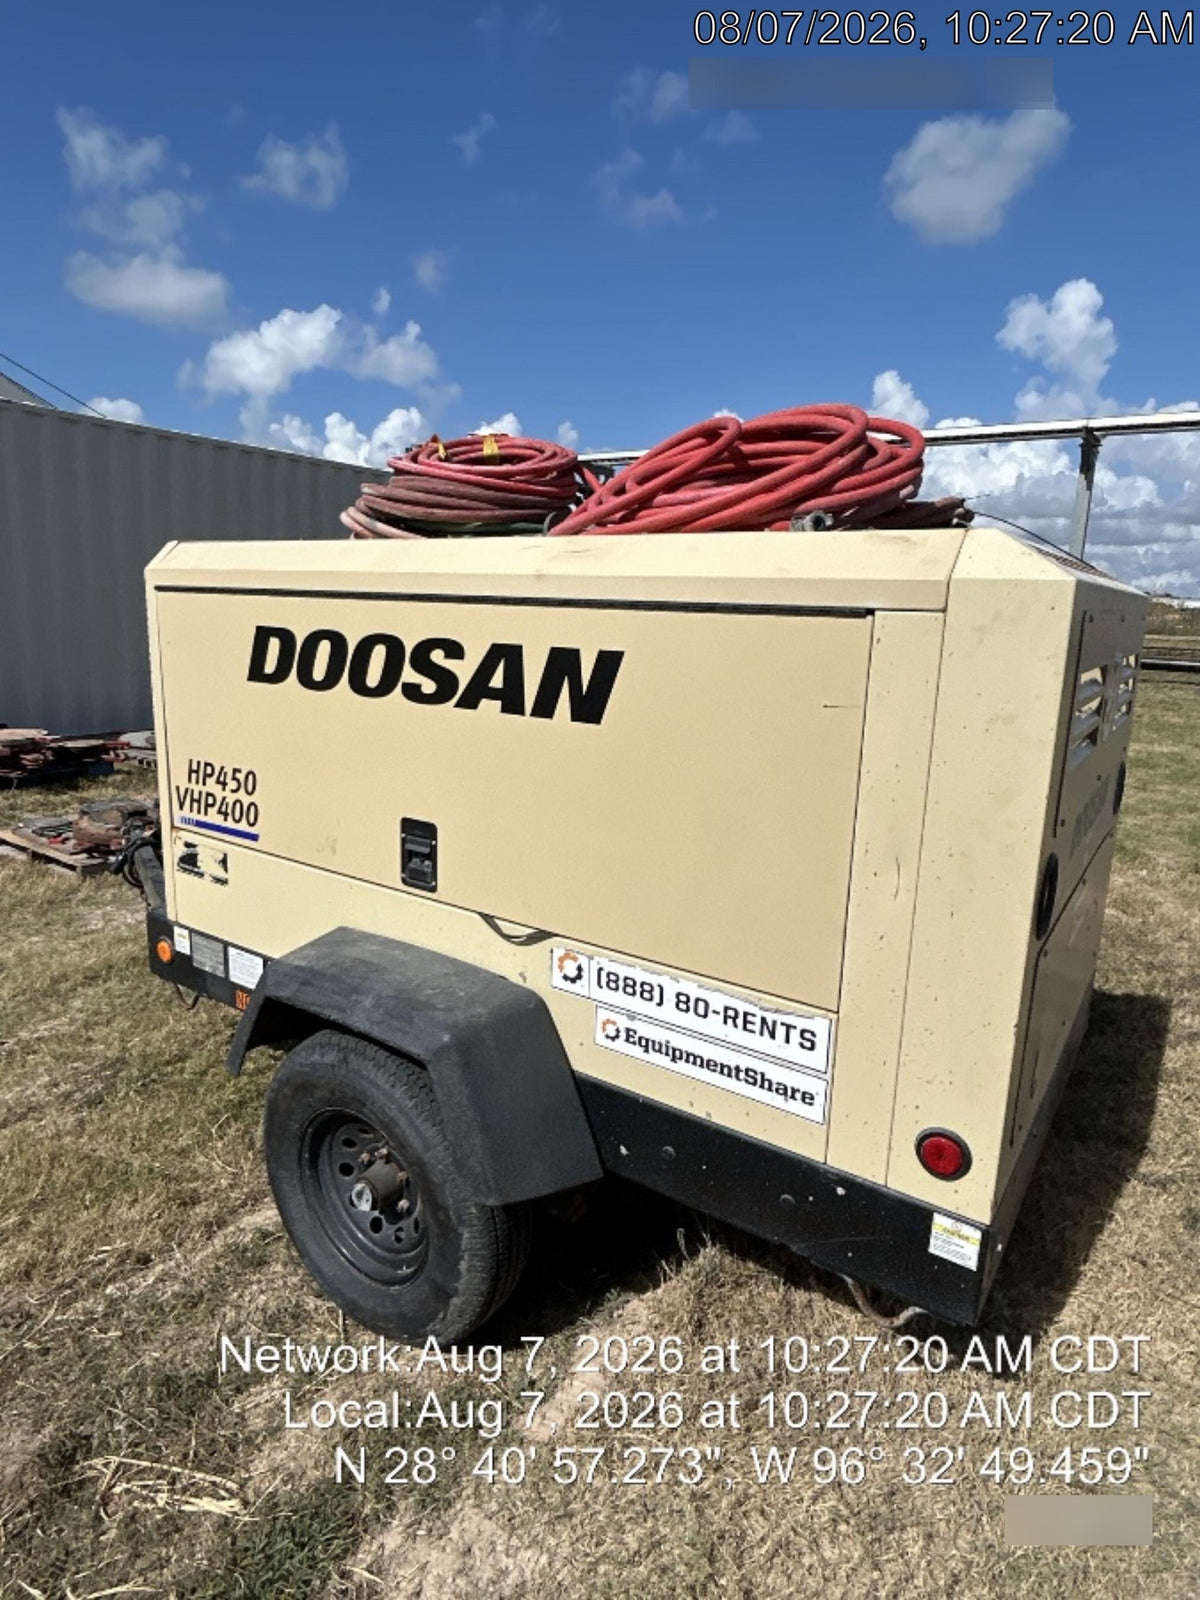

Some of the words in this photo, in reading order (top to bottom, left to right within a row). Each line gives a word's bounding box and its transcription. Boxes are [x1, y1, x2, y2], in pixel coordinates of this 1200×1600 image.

[246, 625, 625, 725] DOOSAN
[175, 785, 259, 827] VHP400
[187, 758, 257, 796] HP450
[596, 966, 664, 1007] (888)
[674, 991, 817, 1052] 80-RENTS
[623, 1026, 815, 1107] EquipmentShare
